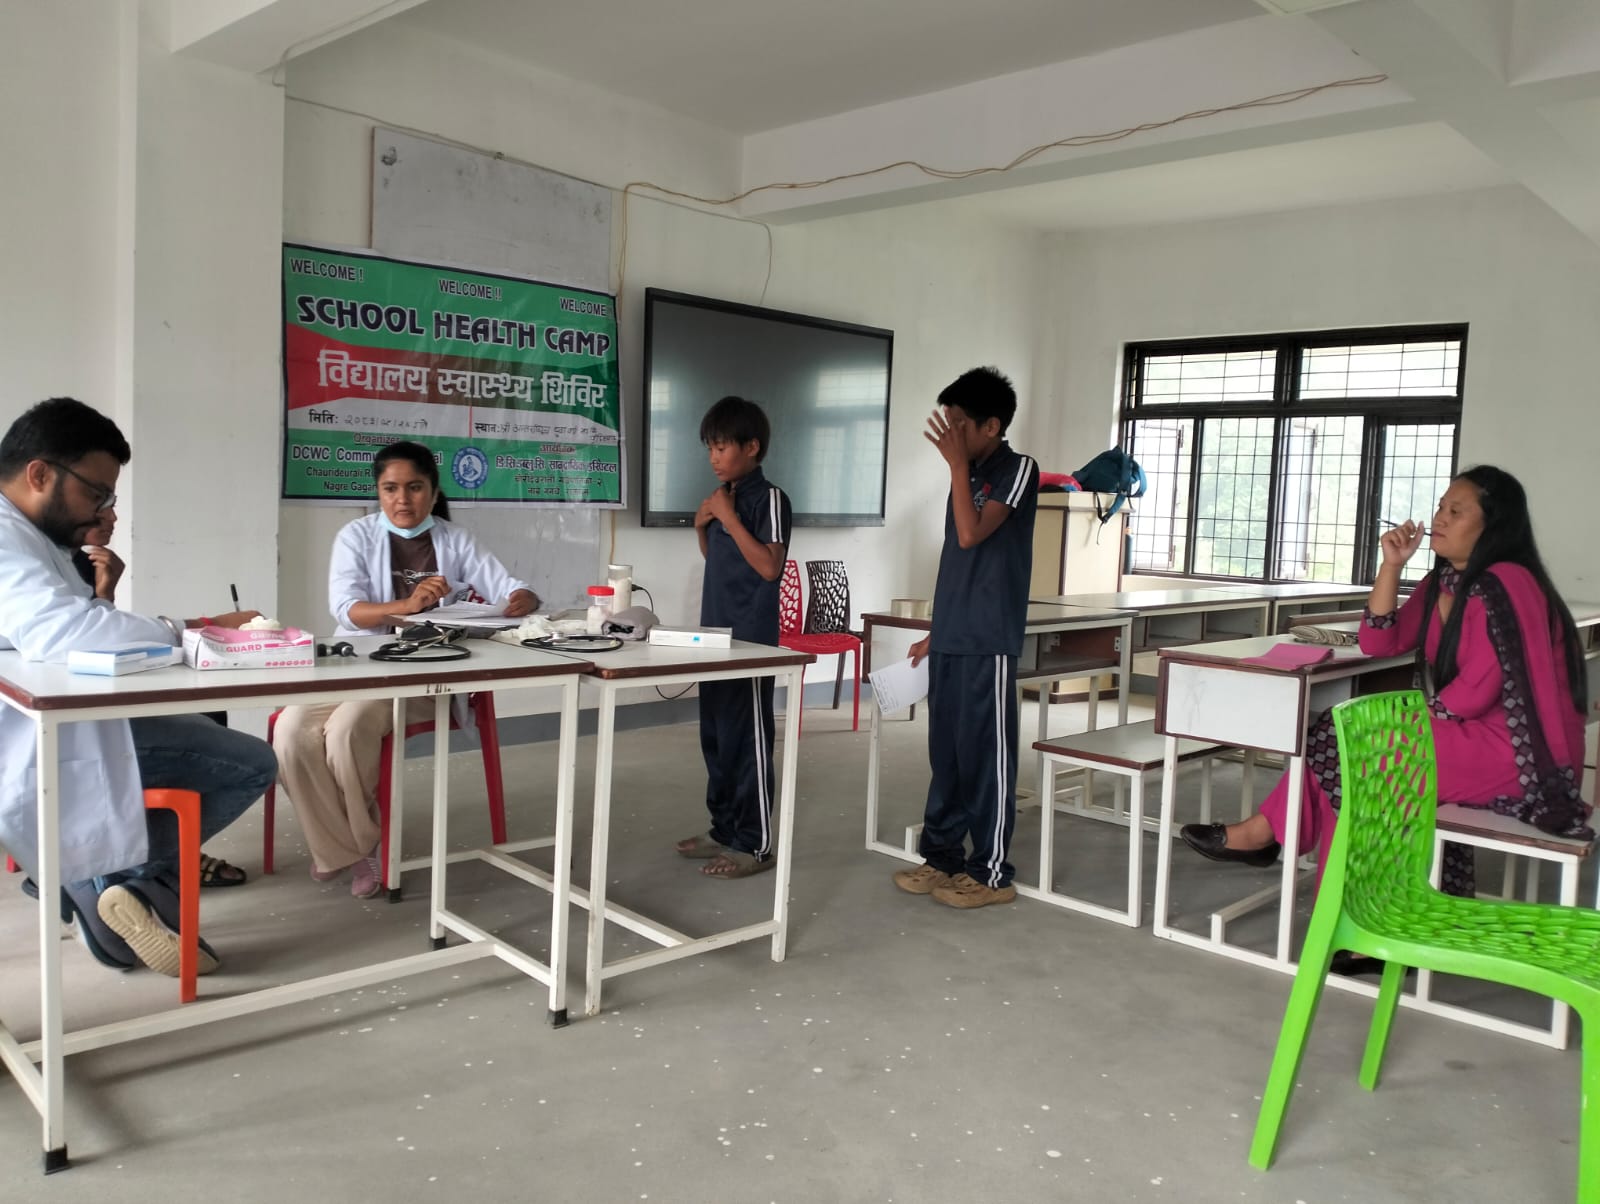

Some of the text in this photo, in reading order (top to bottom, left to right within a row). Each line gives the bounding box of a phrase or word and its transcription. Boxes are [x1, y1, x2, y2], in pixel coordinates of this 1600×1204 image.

[290, 258, 356, 281] WELCOME
[439, 279, 492, 299] WELCOME
[560, 297, 606, 316] WELCOME
[296, 295, 610, 357] SCHOOL HEALTH CAMP
[317, 349, 607, 409] विद्यालय स्वास्थ्य शिविर
[292, 446, 330, 460] DCWC
